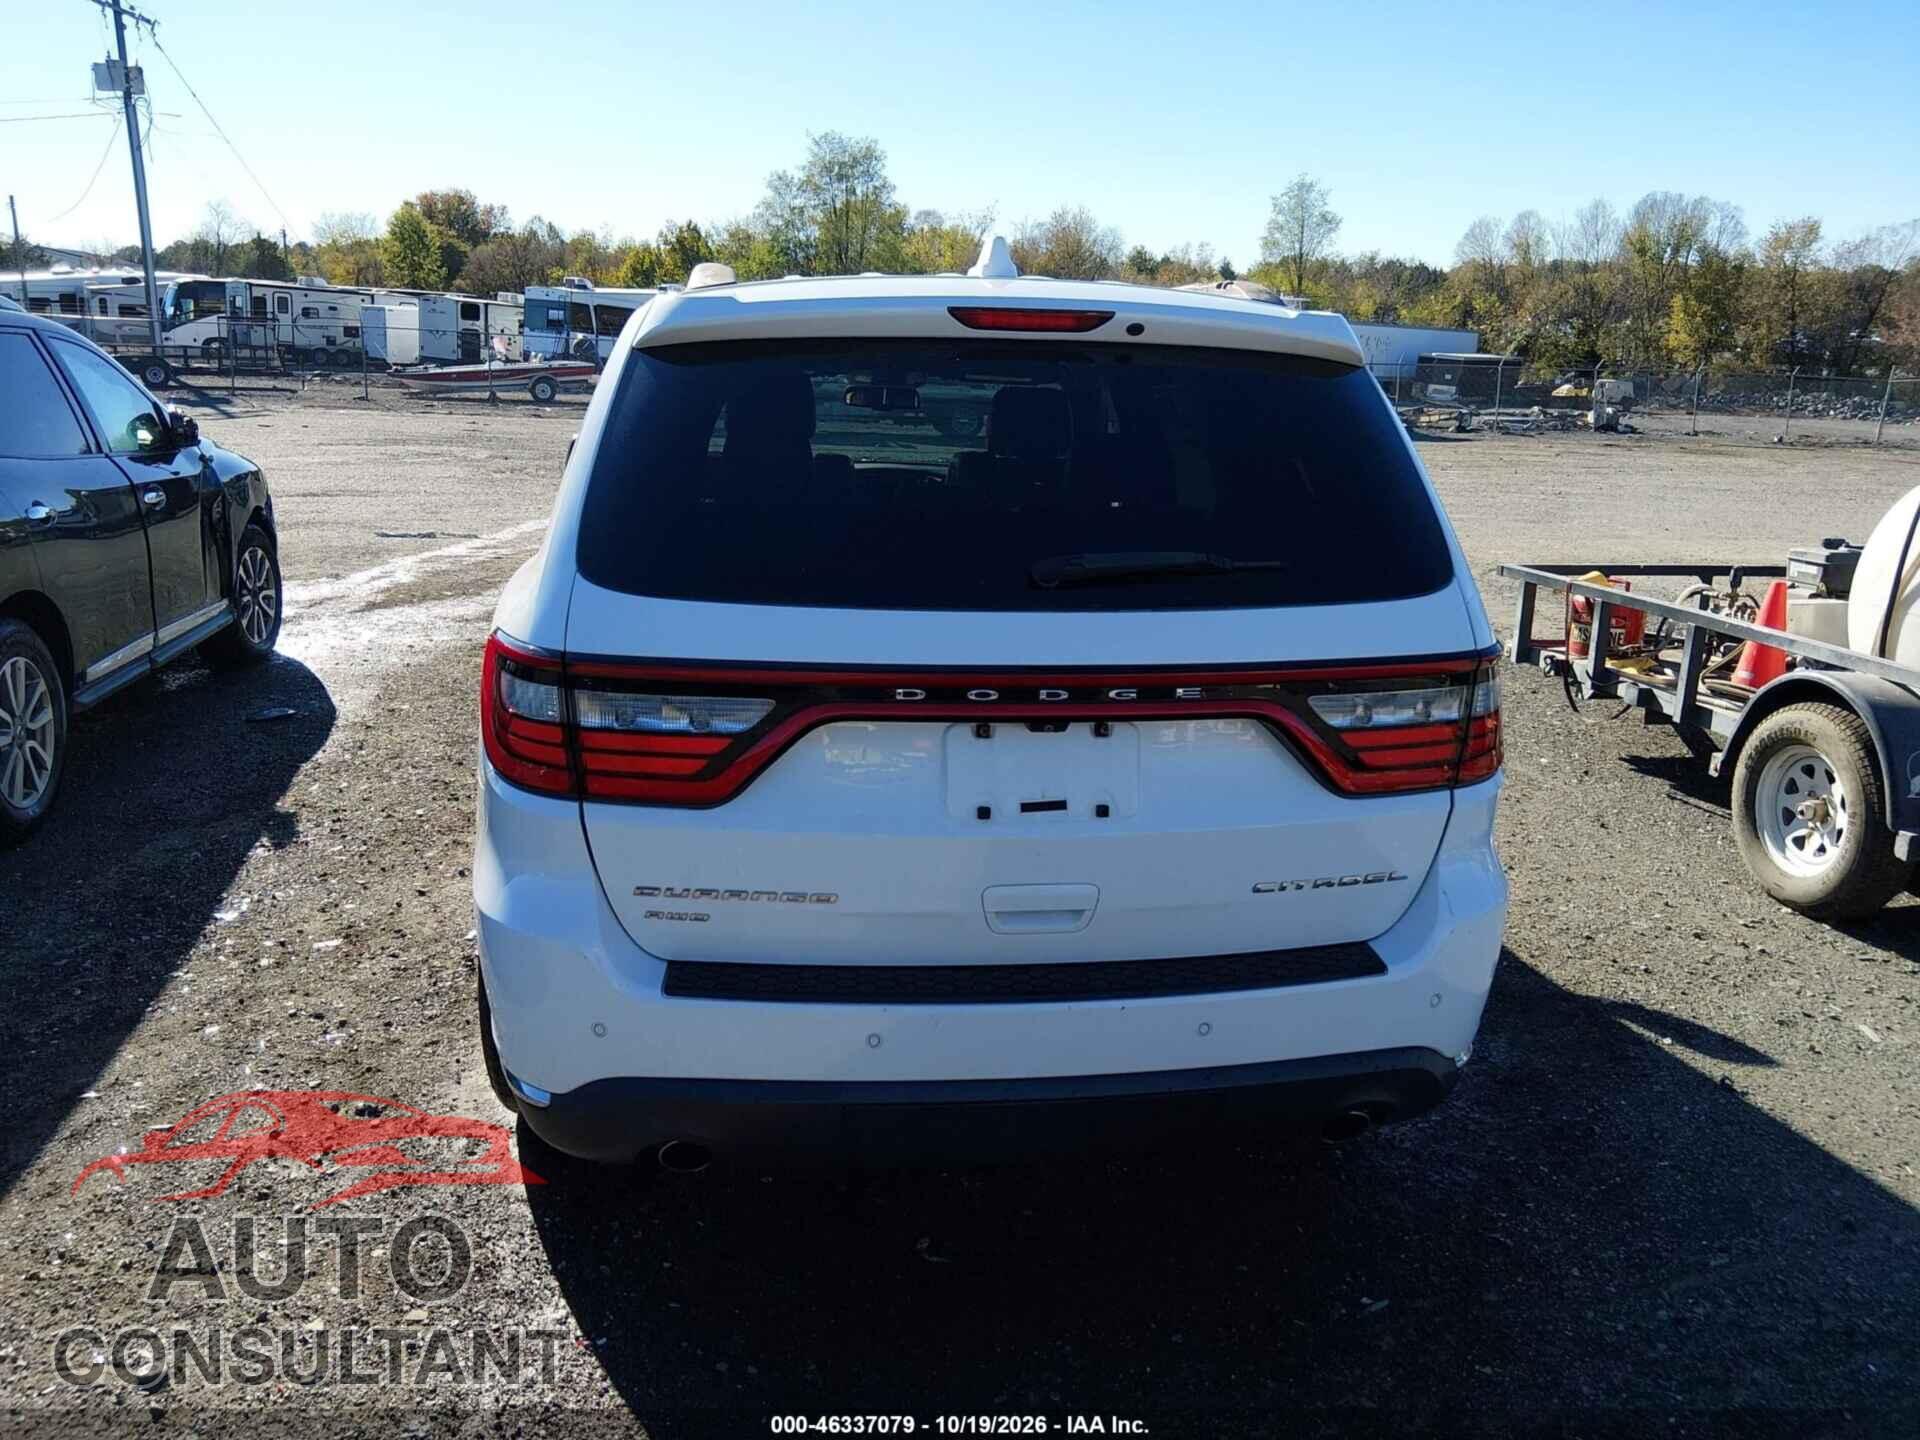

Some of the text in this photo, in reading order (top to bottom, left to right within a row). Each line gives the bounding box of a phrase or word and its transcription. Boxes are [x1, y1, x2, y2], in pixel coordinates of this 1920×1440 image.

[895, 687, 1202, 701] DODGE
[1251, 870, 1409, 894] CITADEL
[632, 885, 840, 905] DURANGO
[643, 909, 711, 923] AWD
